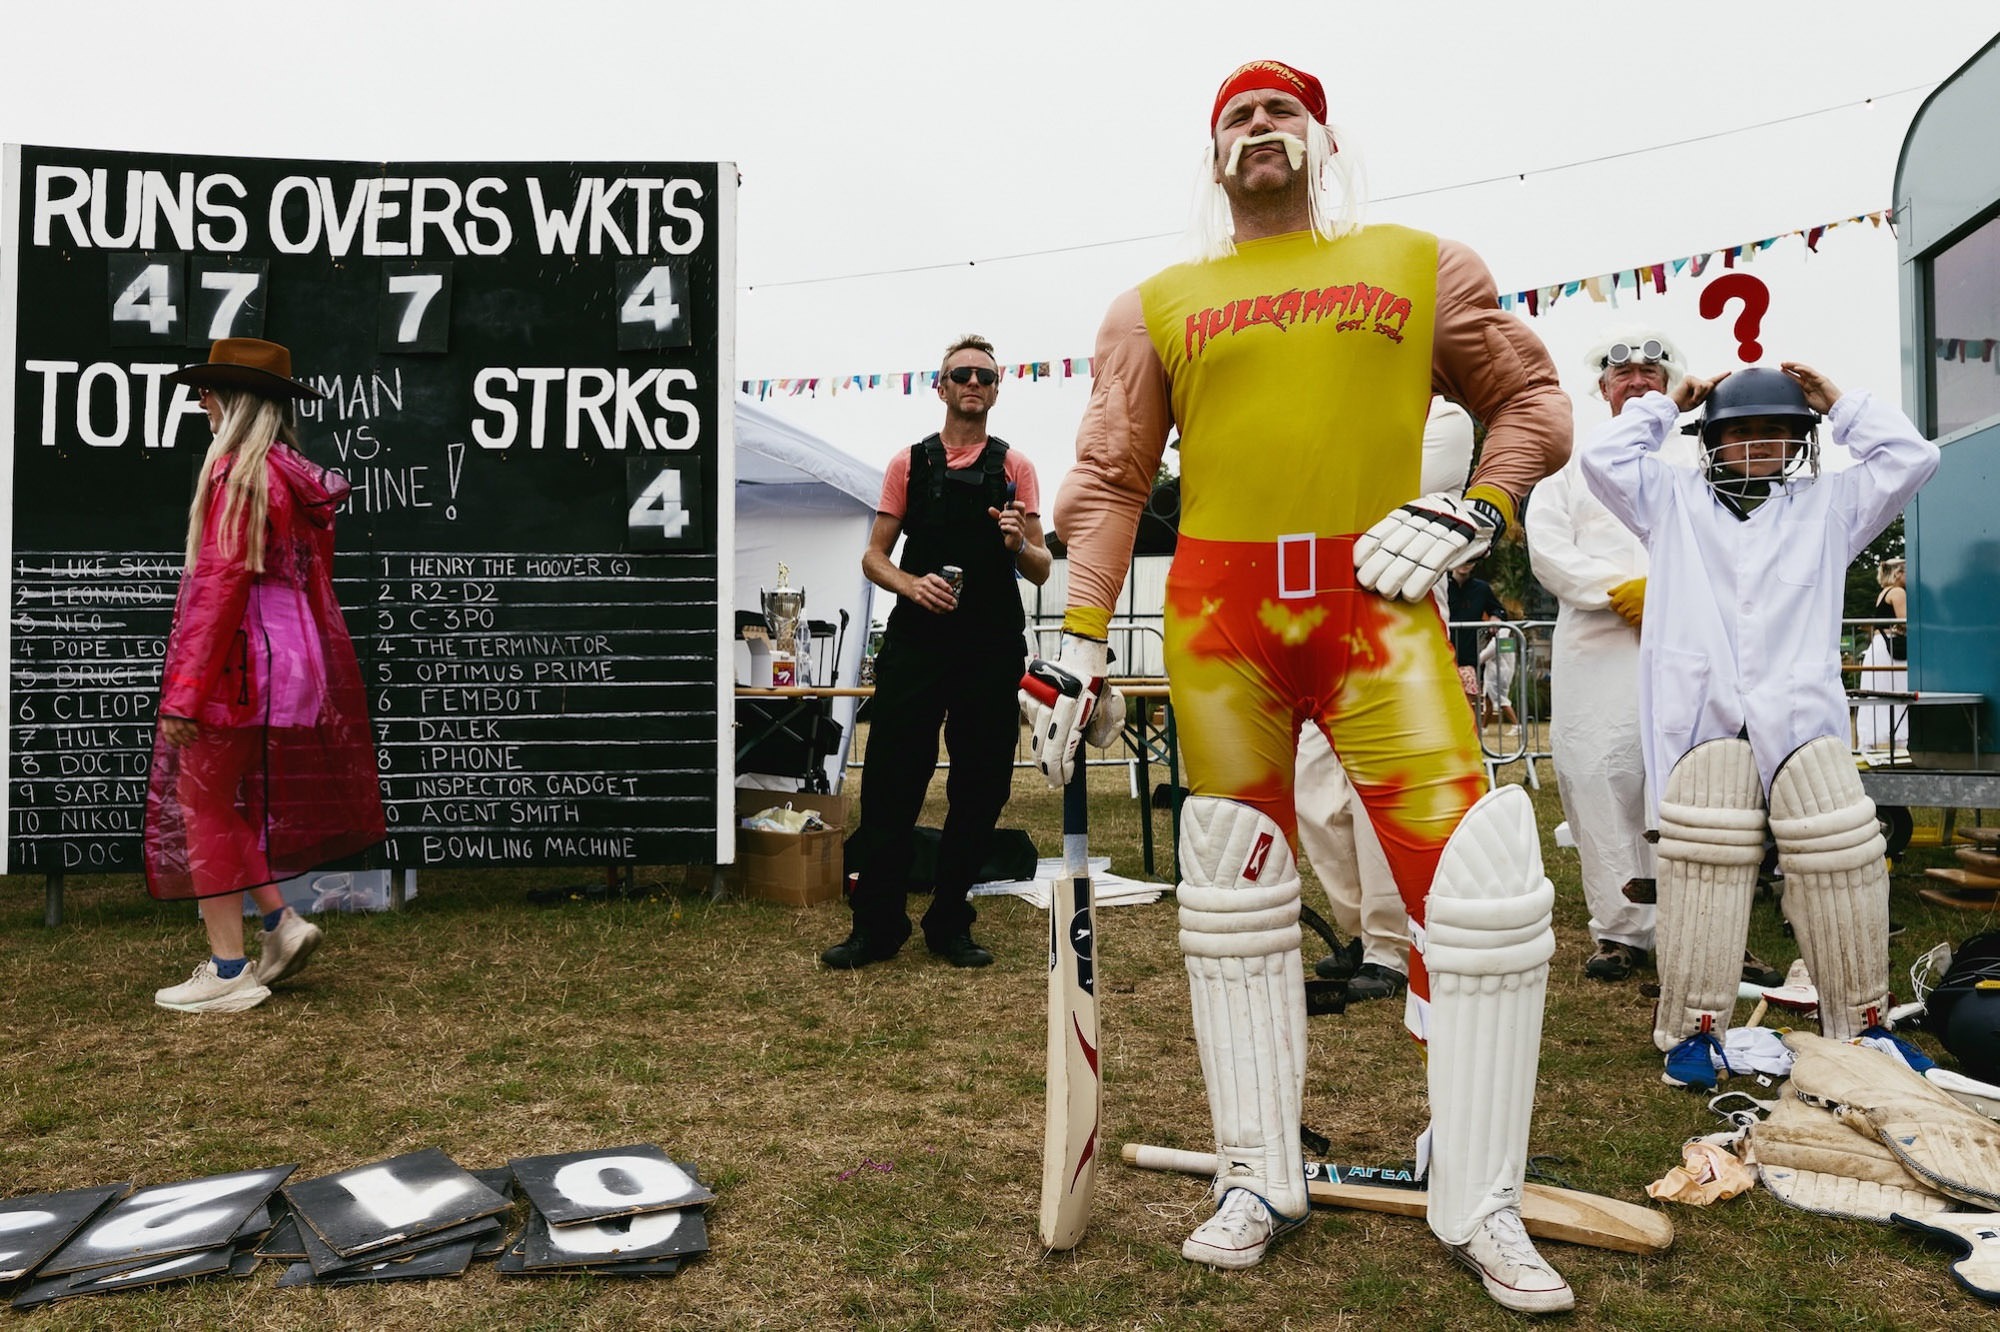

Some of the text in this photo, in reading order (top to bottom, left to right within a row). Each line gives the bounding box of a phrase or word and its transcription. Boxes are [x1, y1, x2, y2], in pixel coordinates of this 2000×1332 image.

[34, 165, 704, 256] RUNS OVERS WKTS
[388, 274, 443, 343] 7
[621, 266, 680, 331] 4
[1186, 282, 1412, 363] HULKAMANIA
[25, 360, 208, 448] TOTA
[471, 367, 699, 450] STRKS
[334, 426, 391, 462] VS.
[628, 469, 689, 538] 4
[18, 558, 183, 578] 1 LUKE SKYW
[381, 557, 389, 576] 1
[410, 557, 475, 577] HENRY
[483, 559, 516, 576] THE
[527, 559, 601, 576] HOOVER
[16, 585, 162, 605] 2 LEONARDO
[379, 582, 499, 602] 2 R2-D2
[19, 613, 101, 632] 3 NEO
[378, 610, 394, 630] 3
[20, 640, 166, 658] 4 POPE LEO
[377, 635, 613, 656] 4 THE TERMINATOR
[20, 668, 37, 687] 5
[56, 665, 137, 687] BRUCE
[378, 661, 615, 682] 5 OPTIMUS PRIME
[20, 695, 157, 720] 6 CLEOP
[378, 688, 541, 712] 6 FEMBOT
[19, 730, 36, 747] 7
[57, 728, 122, 748] HULK
[377, 720, 500, 741] 7 DALEK
[21, 753, 147, 775] 8 DOCTO
[378, 746, 522, 770] 8 iPHONE
[20, 783, 146, 803] 9 SARAH
[380, 776, 638, 796] 9 INSPECTOR GADGET
[20, 811, 143, 832] 10 NIKOL
[387, 801, 580, 823] 0 AGENT SMITH
[20, 842, 37, 865] 11
[64, 842, 123, 867] DOC
[423, 836, 533, 864] BOWLING
[545, 836, 637, 858] MACHINE
